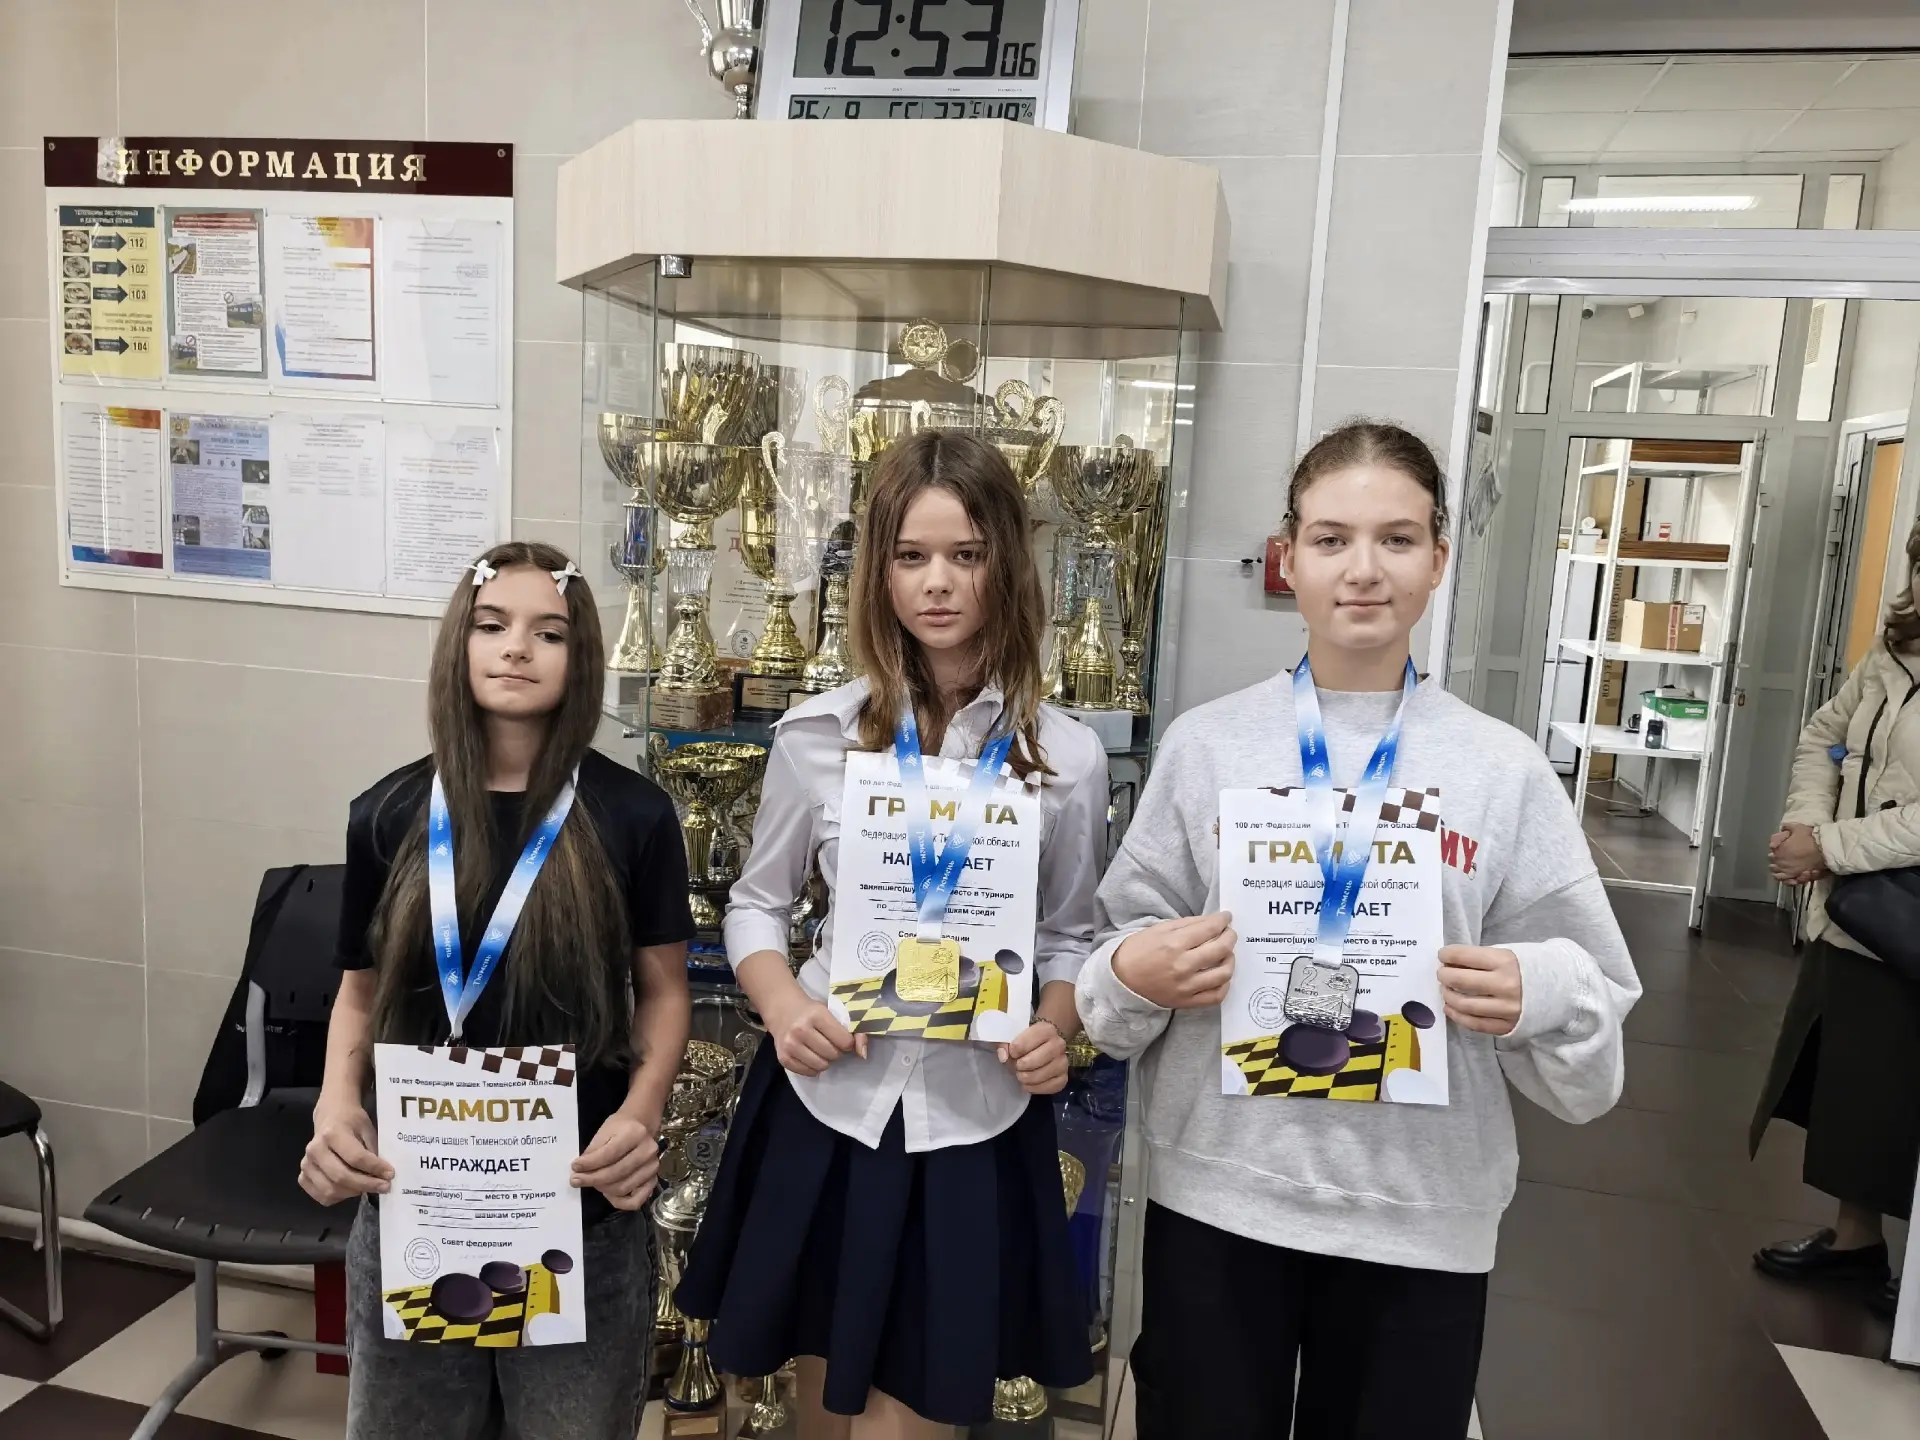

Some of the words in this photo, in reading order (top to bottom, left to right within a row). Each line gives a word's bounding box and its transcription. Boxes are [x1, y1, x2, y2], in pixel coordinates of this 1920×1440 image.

[1001, 42, 1036, 77] 06
[117, 148, 428, 187] ИНФОРМАЦИЯ
[130, 238, 144, 247] 112
[131, 264, 145, 273] 102
[131, 290, 146, 300] 103
[133, 342, 147, 351] 104
[868, 796, 1018, 825] ГРМТА
[1266, 821, 1311, 830] Федерации
[861, 828, 907, 841] Федерация
[986, 837, 1020, 848] области
[1248, 840, 1416, 864] ГРАТА
[936, 859, 955, 893] Тюмень
[1242, 878, 1293, 890] Федерация
[1381, 878, 1419, 889] области
[980, 891, 1015, 900] турнире
[1336, 880, 1353, 917] Тюмень
[970, 909, 995, 917] среди
[1268, 901, 1391, 918] НАГРААЕТ
[1380, 939, 1417, 948] турнире
[1370, 958, 1397, 966] среди
[1302, 966, 1318, 991] 2
[414, 1078, 454, 1087] Федерации
[482, 1080, 526, 1088] Тюменской
[400, 1095, 554, 1122] ГРАМОТА
[397, 1132, 440, 1144] Федерация
[441, 1136, 469, 1146] шашек
[470, 1135, 519, 1146] Тюменской
[520, 1134, 557, 1146] области
[696, 1142, 711, 1158] 2
[420, 1156, 531, 1175] НАГРАЖДАЕТ
[485, 1192, 510, 1200] место
[520, 1191, 557, 1201] турнире
[511, 1211, 537, 1220] среди
[441, 1238, 465, 1247] Совет
[466, 1240, 513, 1249] федерации
